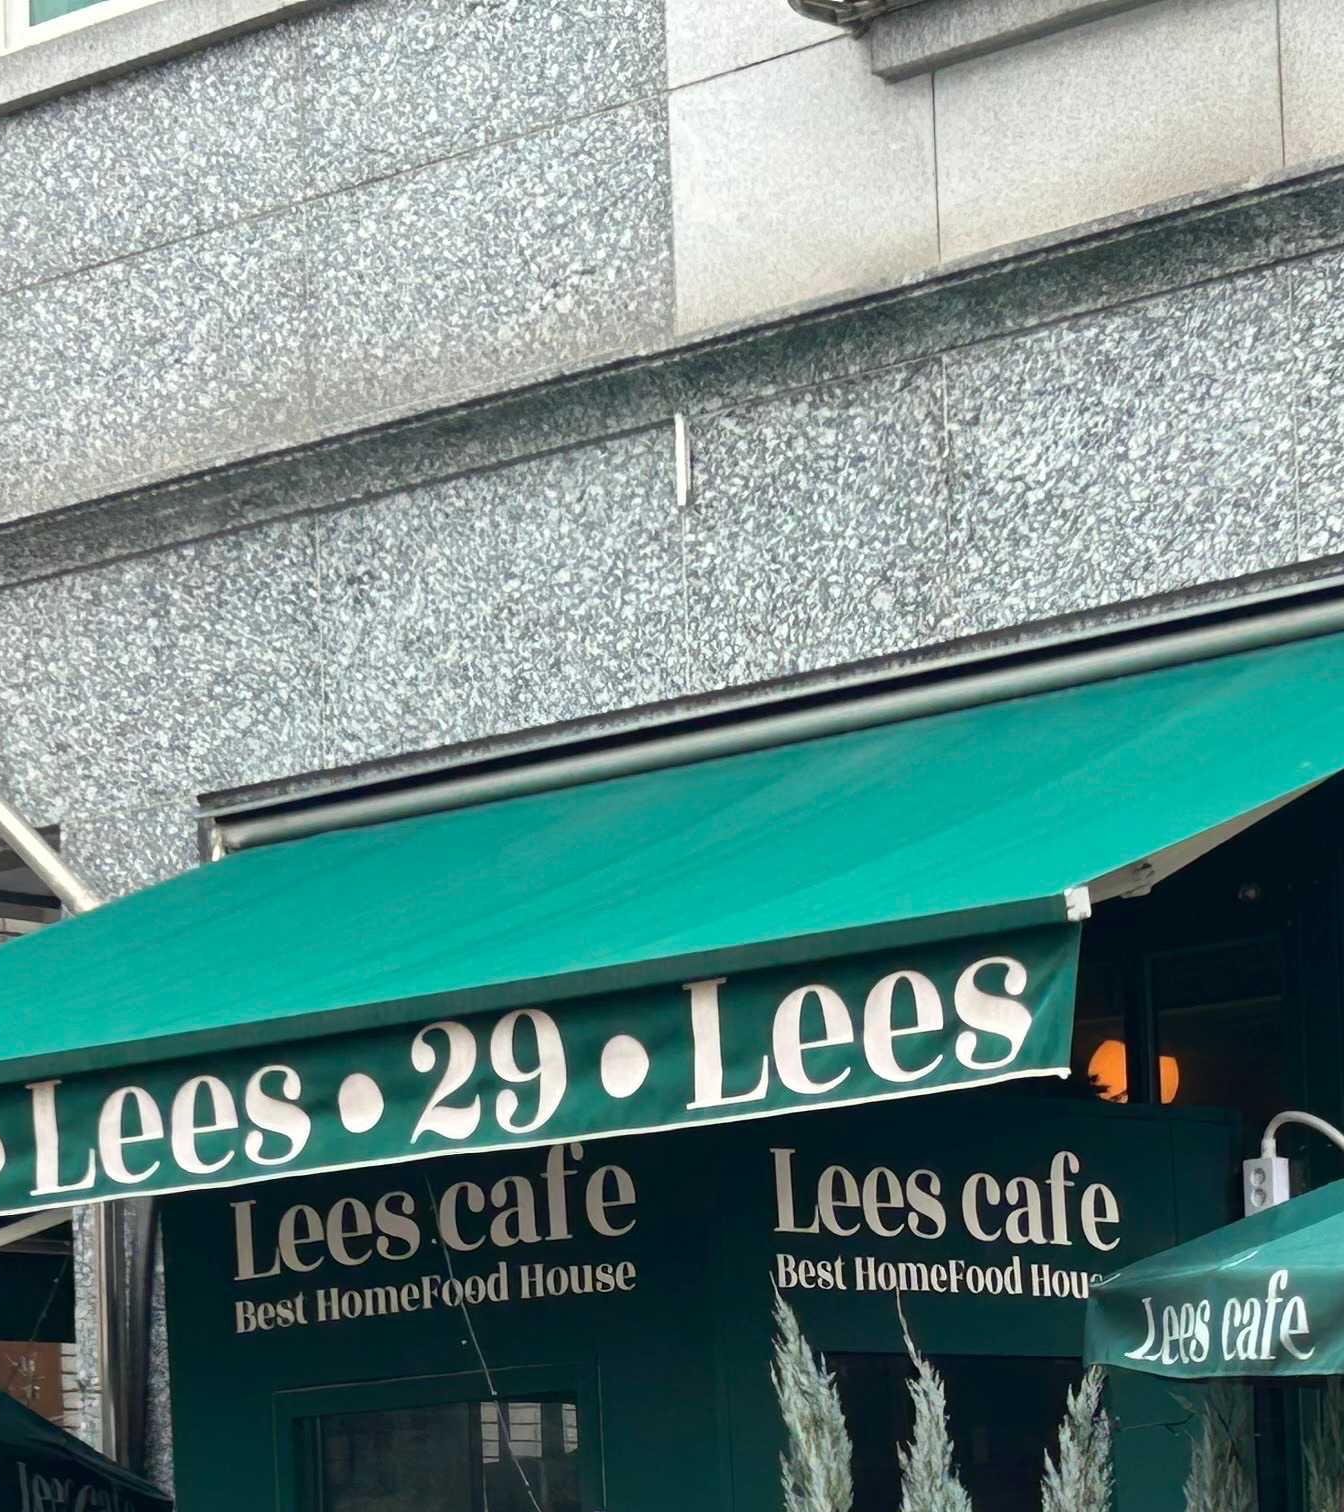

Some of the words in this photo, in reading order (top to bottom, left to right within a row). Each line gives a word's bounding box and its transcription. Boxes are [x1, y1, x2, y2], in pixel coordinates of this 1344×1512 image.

[24, 1064, 311, 1197] Lees
[410, 1008, 567, 1145] 29
[683, 955, 1033, 1111] Lees
[229, 1190, 421, 1281] Lees
[439, 1142, 637, 1252] cafe
[769, 1147, 947, 1240] Lees
[961, 1150, 1121, 1252] cafe
[235, 1292, 308, 1334] Best
[316, 1261, 509, 1323] HomeFood
[520, 1260, 637, 1299] House
[776, 1253, 847, 1290] Best
[1124, 1295, 1210, 1365] Lees
[1222, 1269, 1316, 1361] cafe
